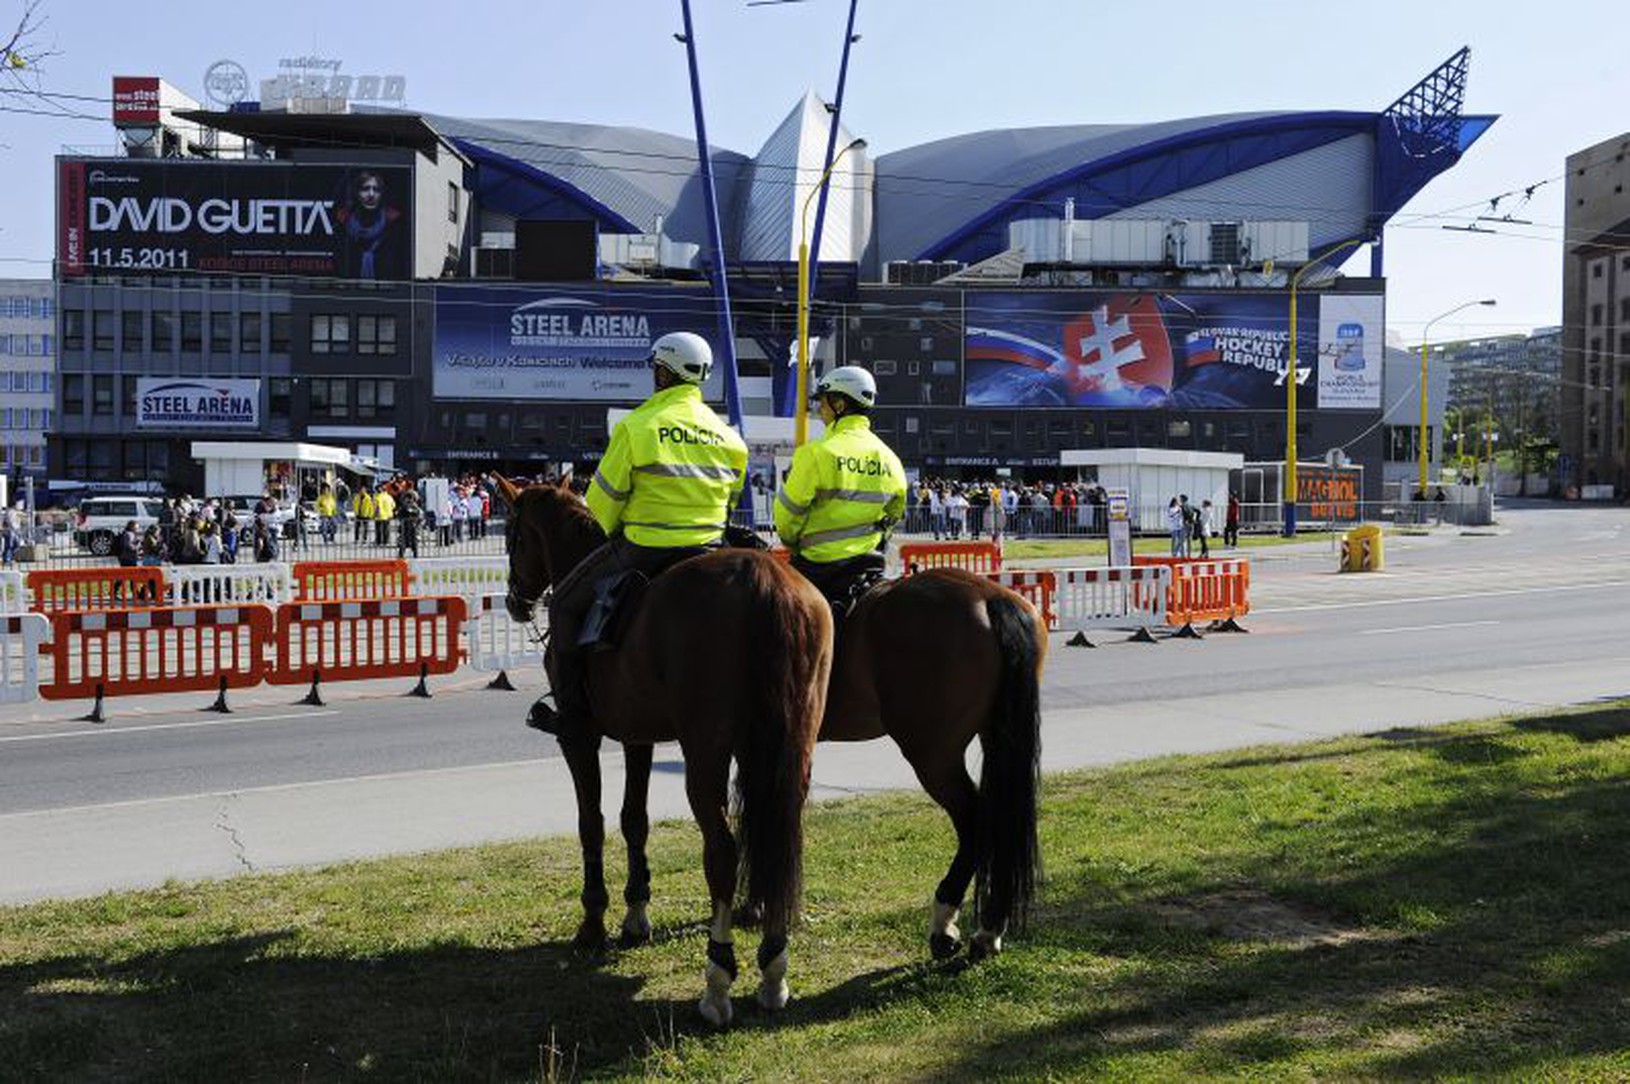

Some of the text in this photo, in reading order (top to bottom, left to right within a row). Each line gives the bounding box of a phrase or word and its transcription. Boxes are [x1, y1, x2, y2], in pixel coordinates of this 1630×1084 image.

[89, 197, 335, 236] DAVID GUETTA
[89, 247, 189, 269] 11.5.2011
[510, 314, 651, 337] STEEL ARENA
[1214, 336, 1284, 358] HOCKEY
[580, 357, 646, 370] Welcome
[143, 396, 253, 414] STEEL ARENA
[447, 450, 491, 460] ENTRANCE
